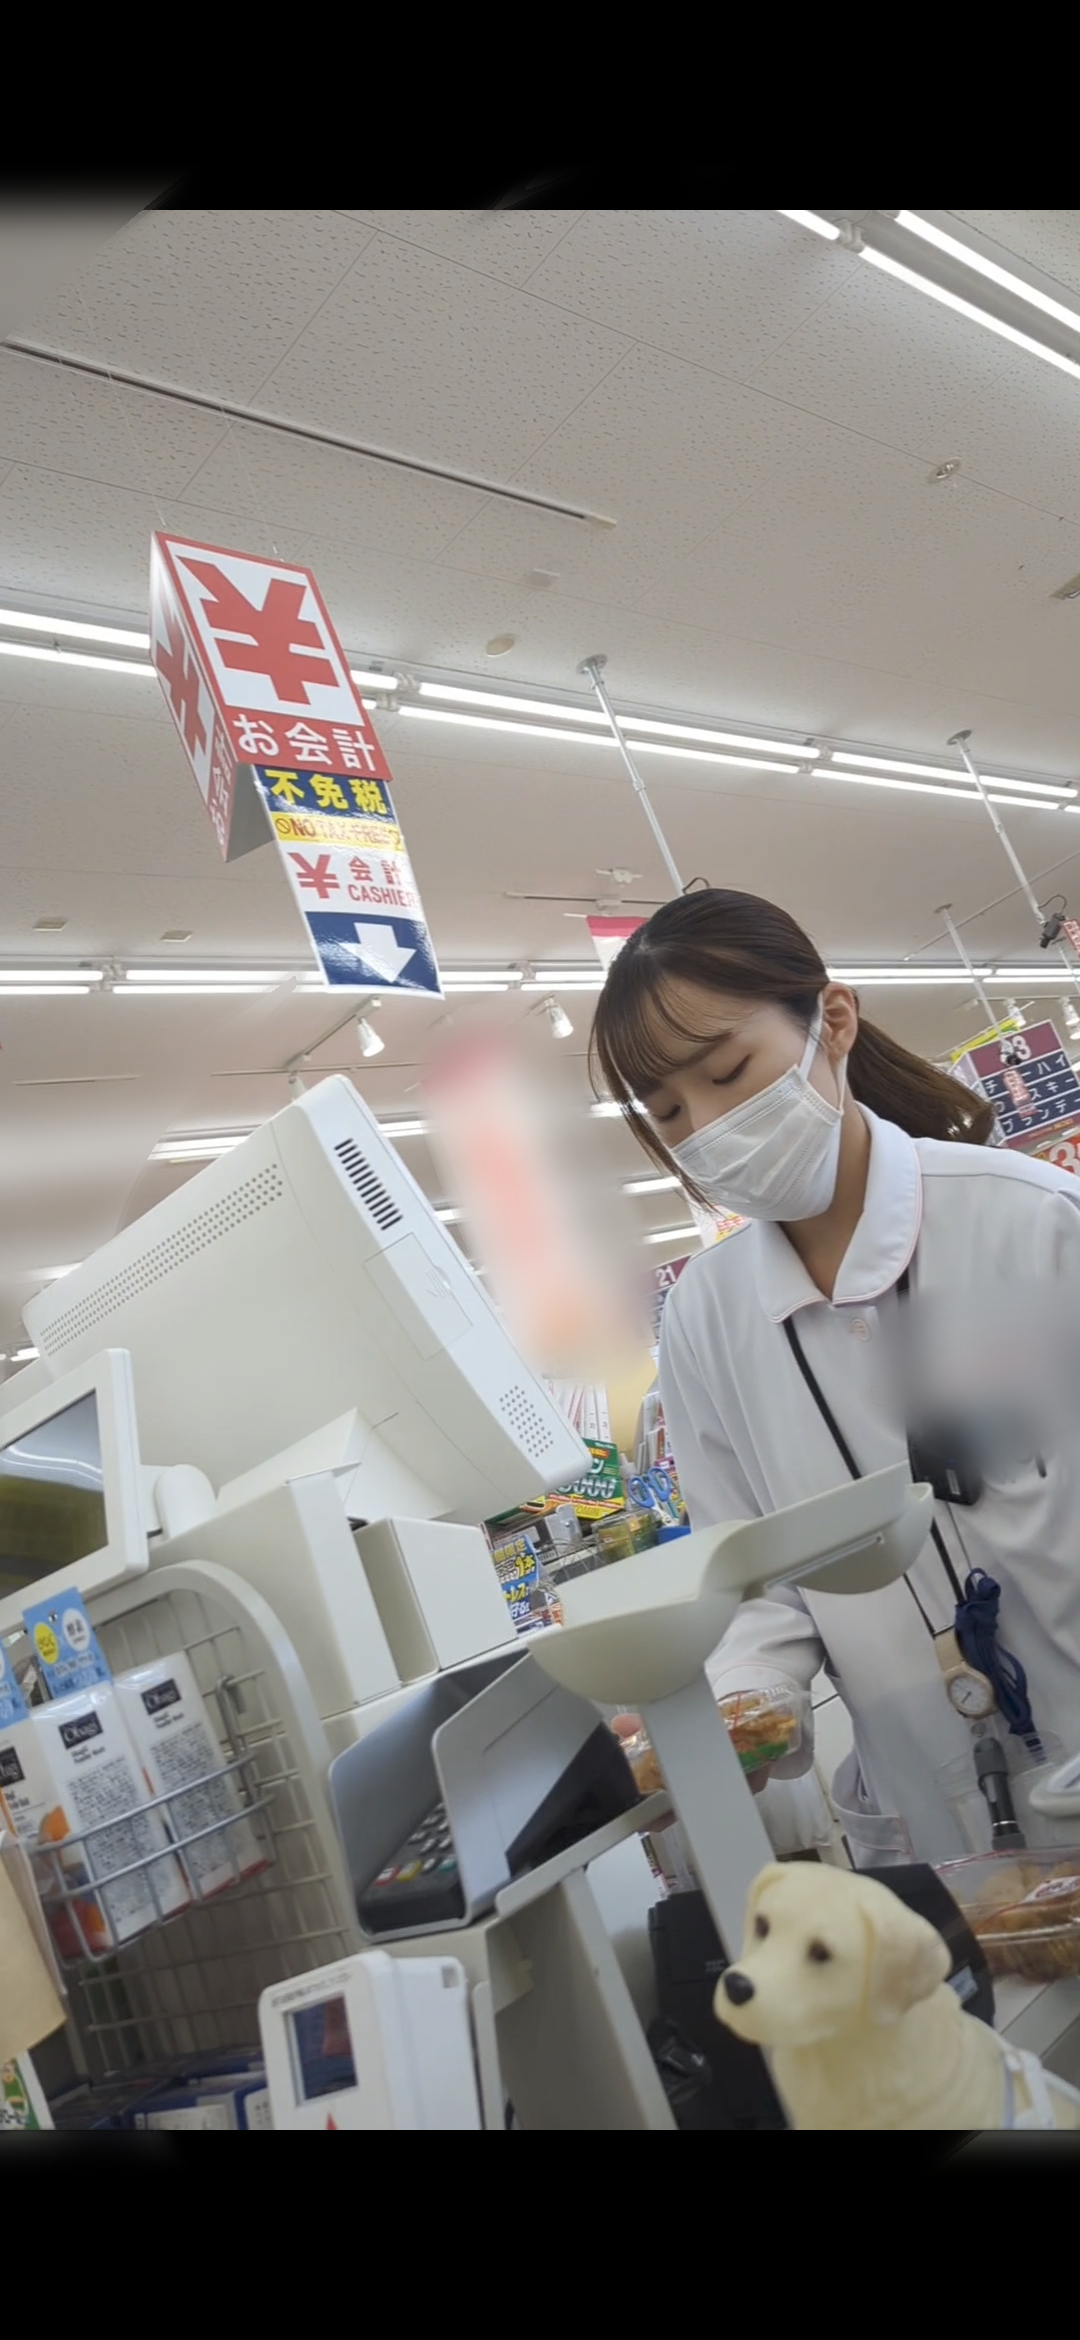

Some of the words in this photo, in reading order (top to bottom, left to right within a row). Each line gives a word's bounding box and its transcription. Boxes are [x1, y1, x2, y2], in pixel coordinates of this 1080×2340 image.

[233, 713, 377, 772] お会計
[264, 769, 387, 815] 不免税
[289, 819, 317, 838] NO
[347, 884, 418, 908] CASHIER
[985, 1053, 1068, 1095] チーハイ
[655, 1265, 677, 1287] 21
[64, 1718, 101, 1743] Obagi
